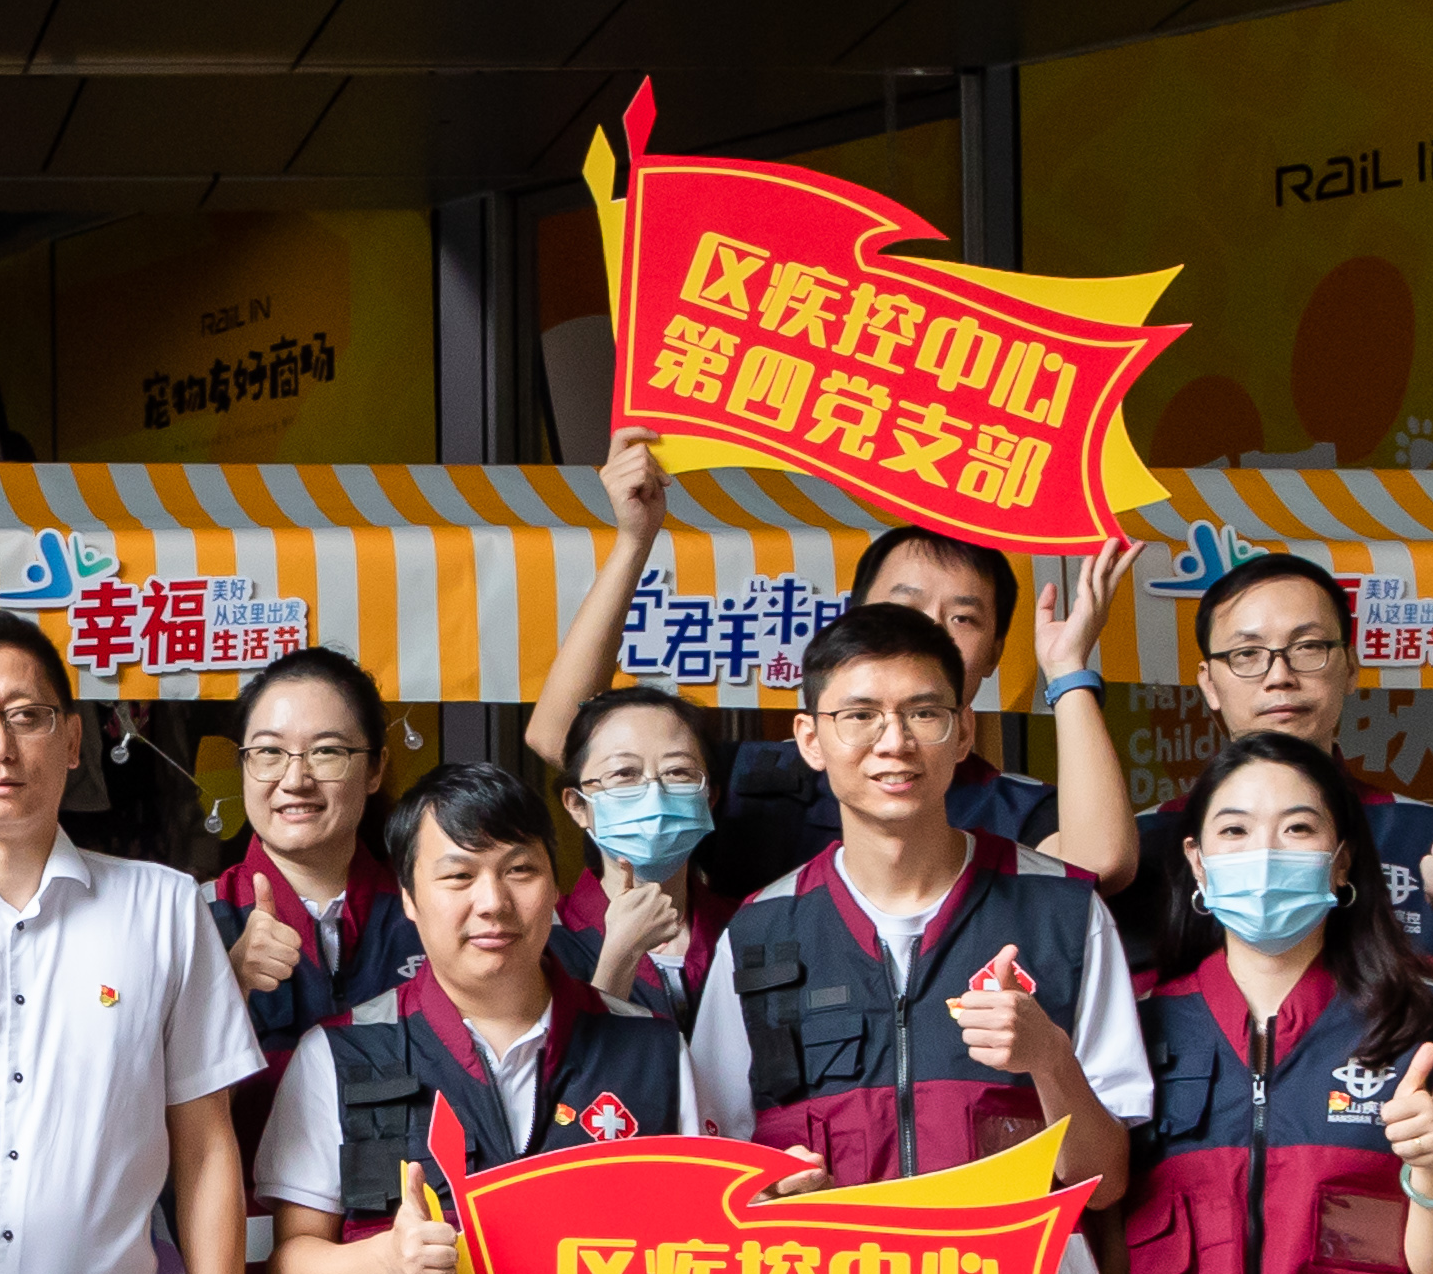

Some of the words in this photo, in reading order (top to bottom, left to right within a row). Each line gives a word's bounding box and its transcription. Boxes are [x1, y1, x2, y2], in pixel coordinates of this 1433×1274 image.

[679, 231, 1077, 428] 区疾控中心
[647, 314, 1053, 511] 第四党支部
[212, 579, 246, 602] 美好
[1364, 578, 1400, 600] 美好
[73, 579, 209, 669] 幸福
[213, 602, 301, 627] 从这里出发
[210, 626, 300, 662] 生活节
